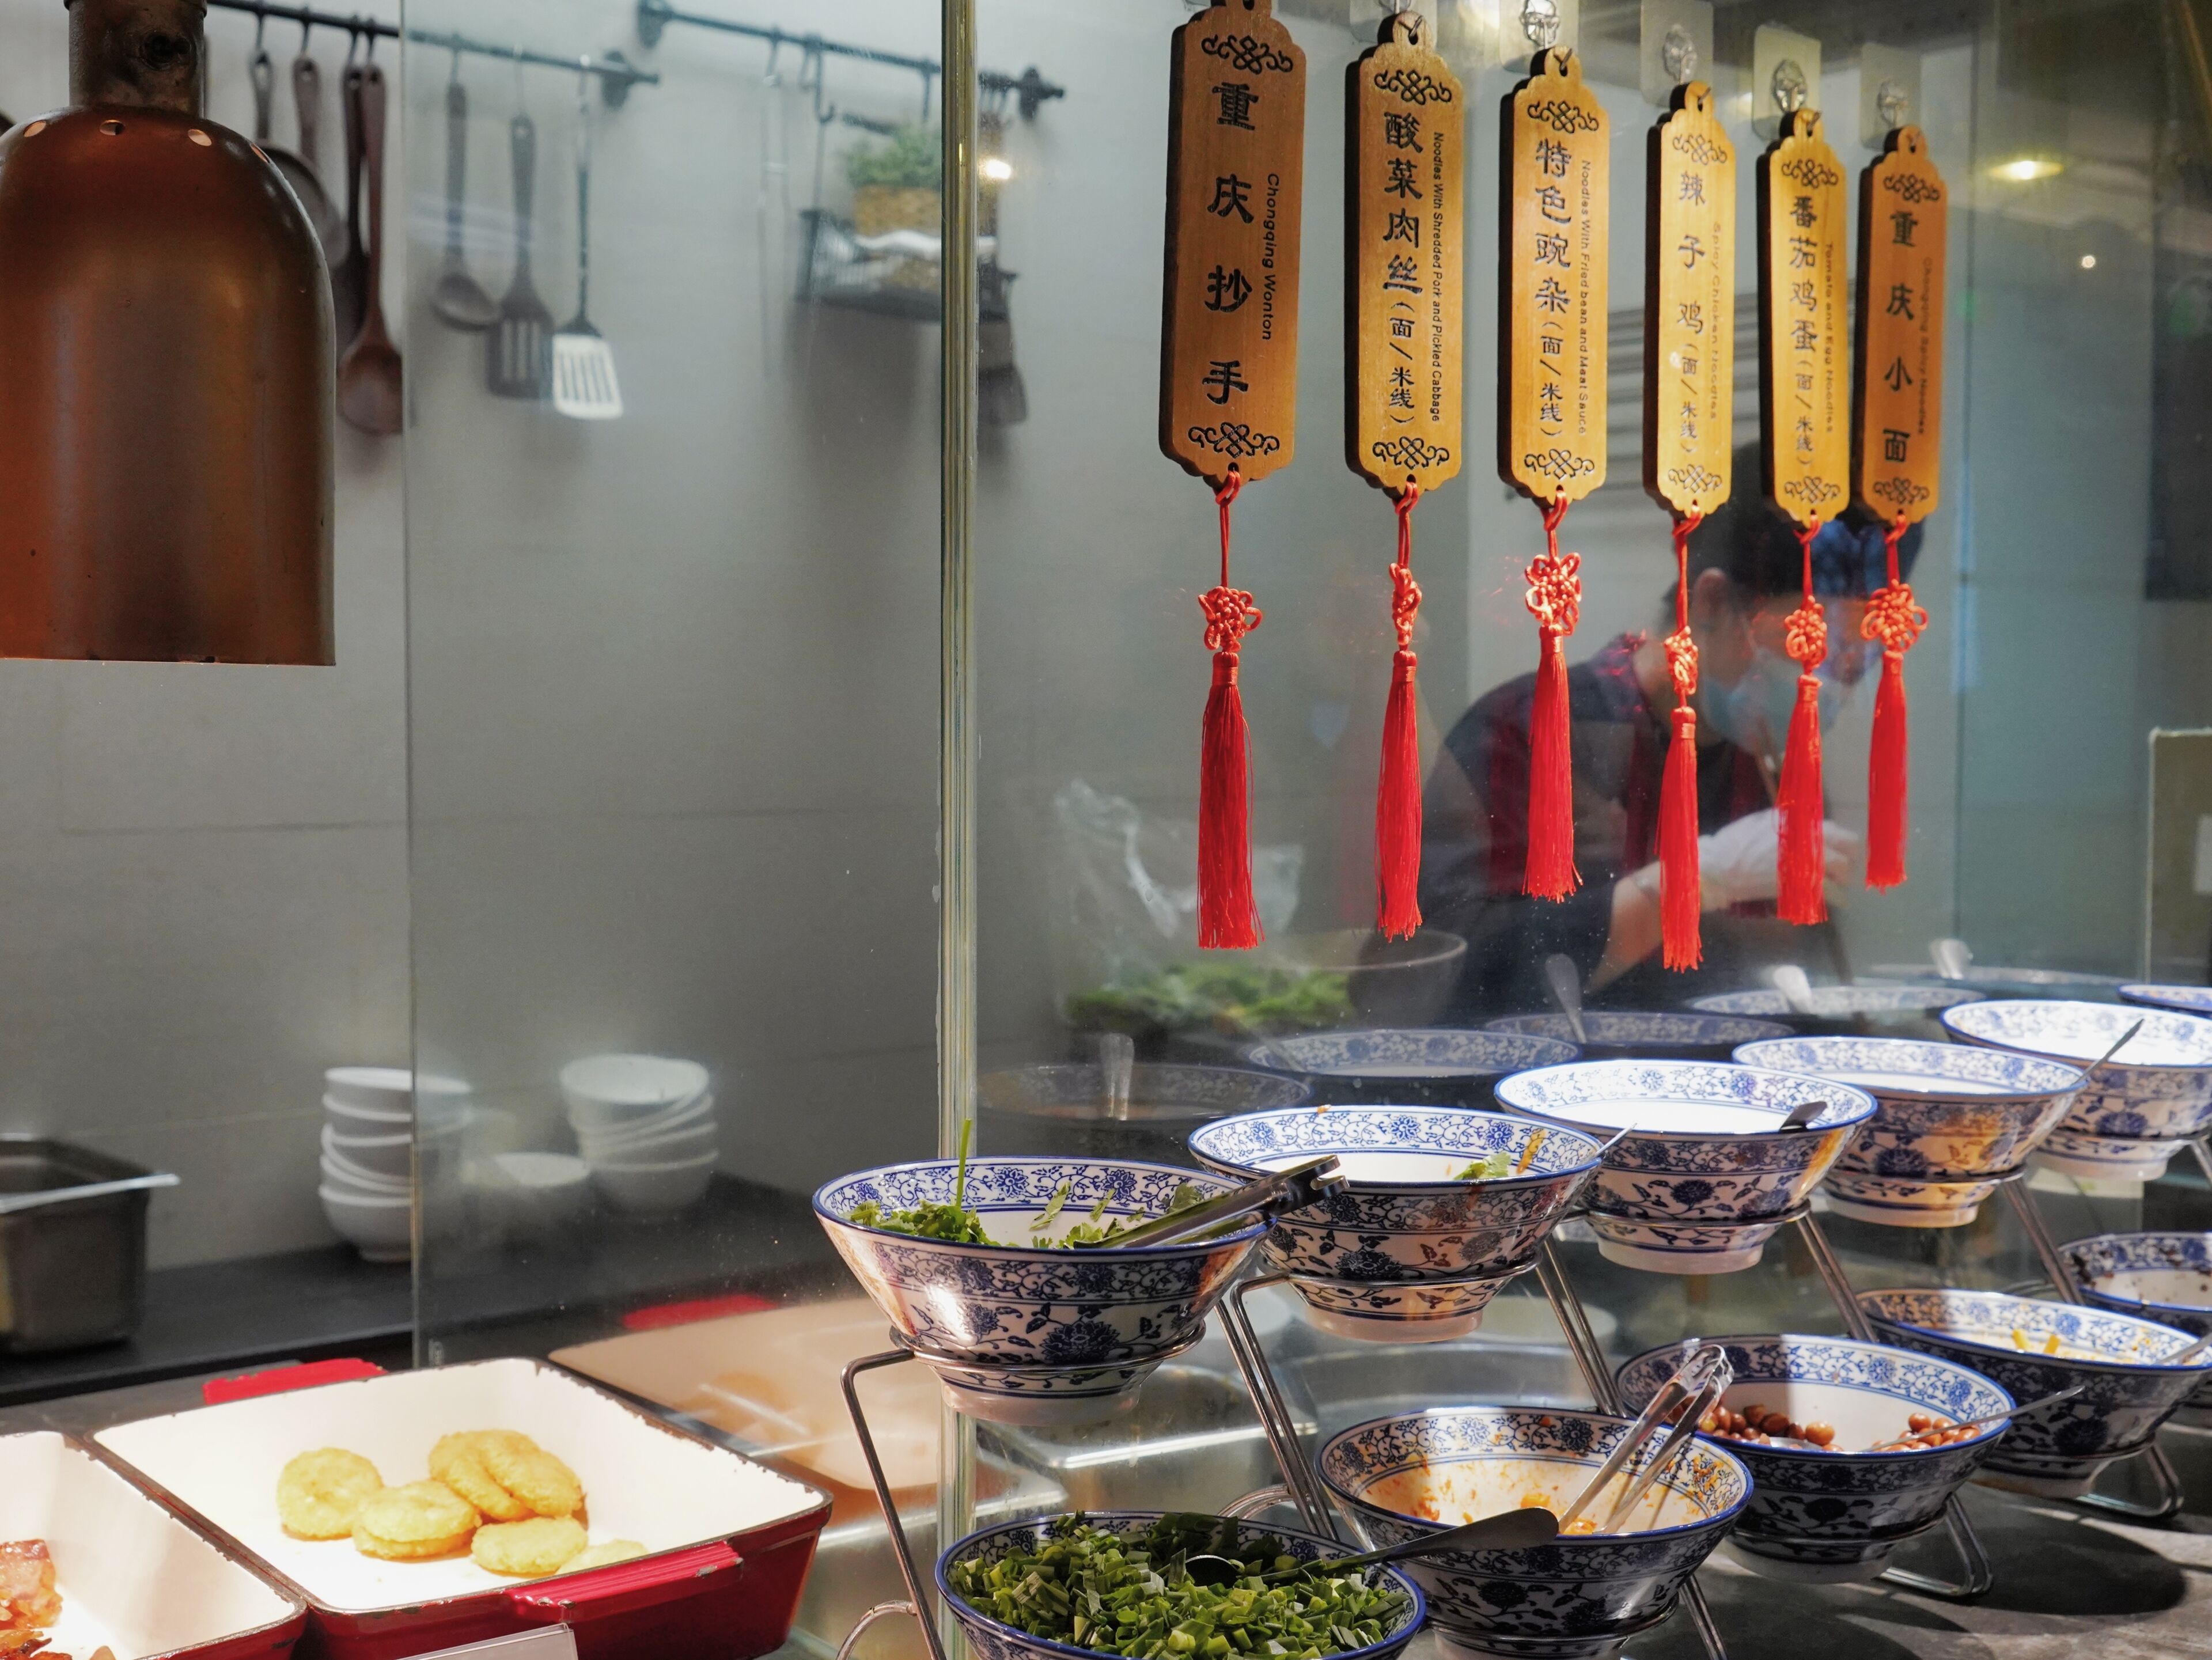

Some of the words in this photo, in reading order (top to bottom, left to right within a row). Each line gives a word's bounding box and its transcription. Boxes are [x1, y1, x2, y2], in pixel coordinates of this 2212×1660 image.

[1433, 132, 1444, 180] Noodles
[1433, 184, 1444, 209] With
[1581, 160, 1590, 215] Noodles
[1262, 173, 1280, 269] Chongqing
[1433, 213, 1443, 269] Shredded
[1581, 220, 1591, 249] With
[1202, 81, 1259, 404] 重庆抄手
[1433, 272, 1442, 297] Pork
[1580, 253, 1590, 288] Fried
[1262, 274, 1276, 340] Wonton
[1433, 302, 1442, 326] and
[1580, 291, 1589, 324] bean
[1432, 325, 1442, 367] Pickled
[1579, 328, 1589, 352] and
[1882, 210, 1918, 462] 重庆小面
[1430, 370, 1441, 422] Cabbage
[1578, 392, 1588, 434] Sauce
